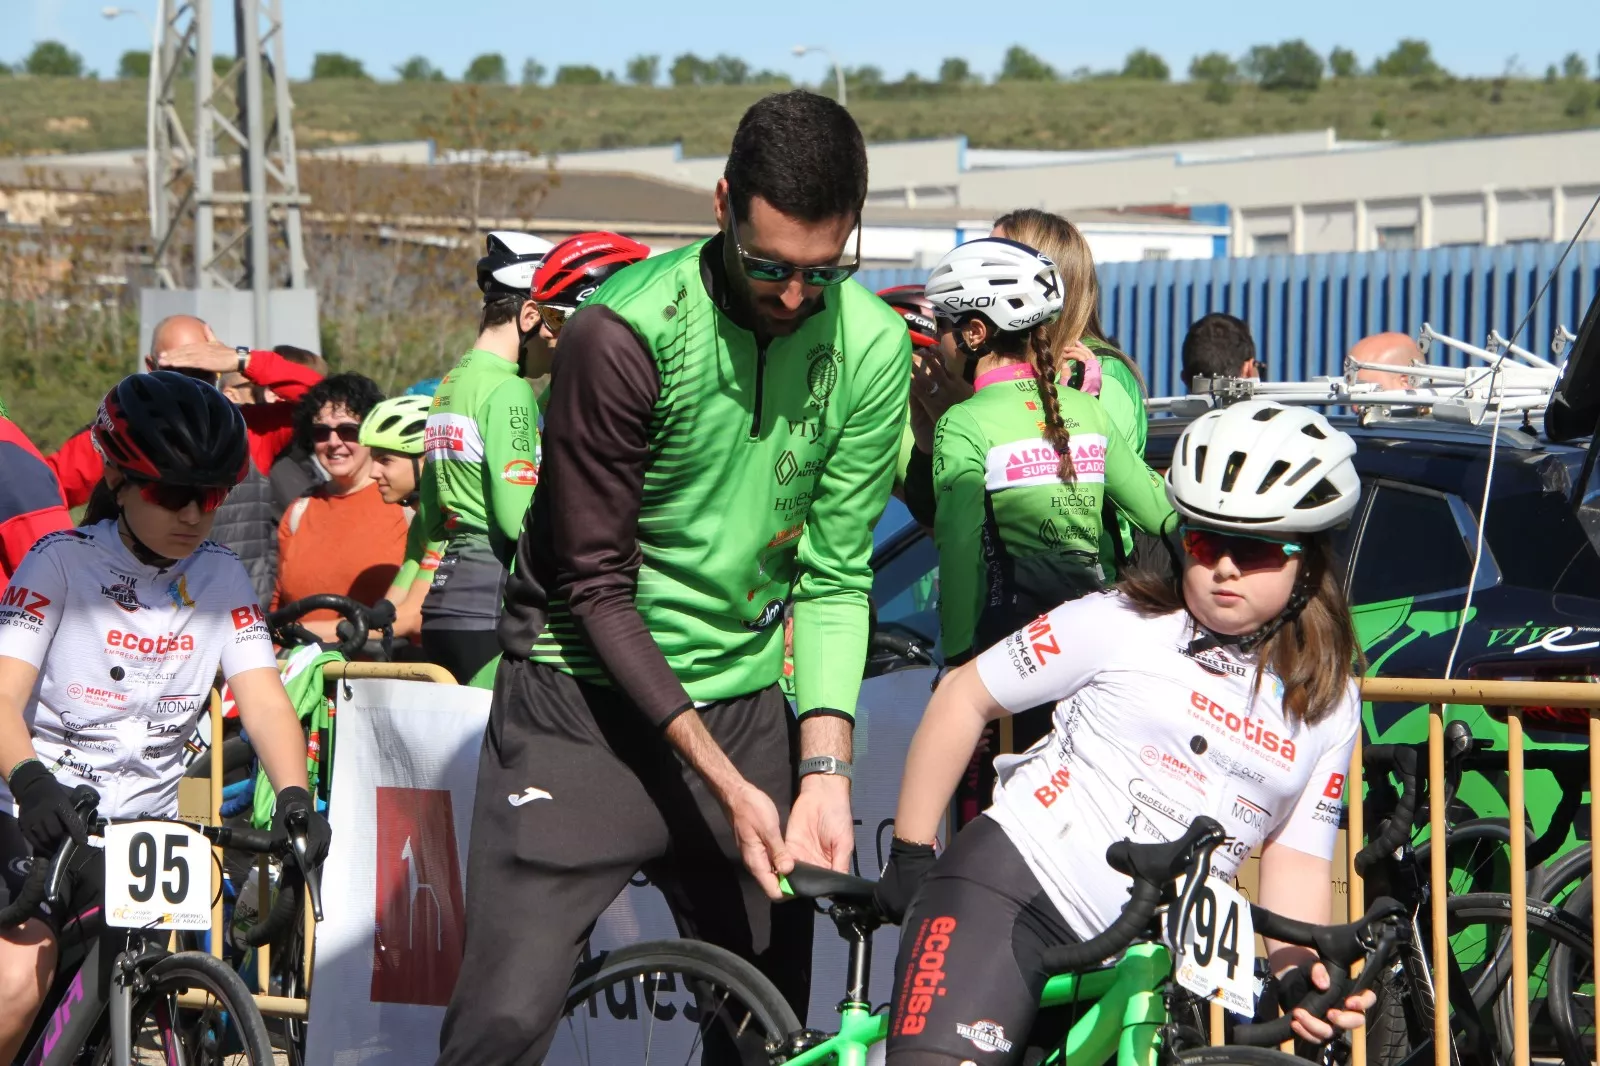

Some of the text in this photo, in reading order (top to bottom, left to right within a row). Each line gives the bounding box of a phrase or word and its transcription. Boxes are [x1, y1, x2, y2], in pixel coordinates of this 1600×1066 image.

[13, 620, 40, 634] STORE
[106, 629, 195, 655] ecotisa
[86, 686, 129, 703] MAPFRE
[1190, 689, 1297, 763] ecotisa
[1161, 752, 1208, 785] MAPFRE
[127, 831, 190, 905] 95
[1192, 885, 1241, 981] 94
[901, 916, 957, 1036] ecotisa
[956, 1024, 996, 1044] TALLERES
